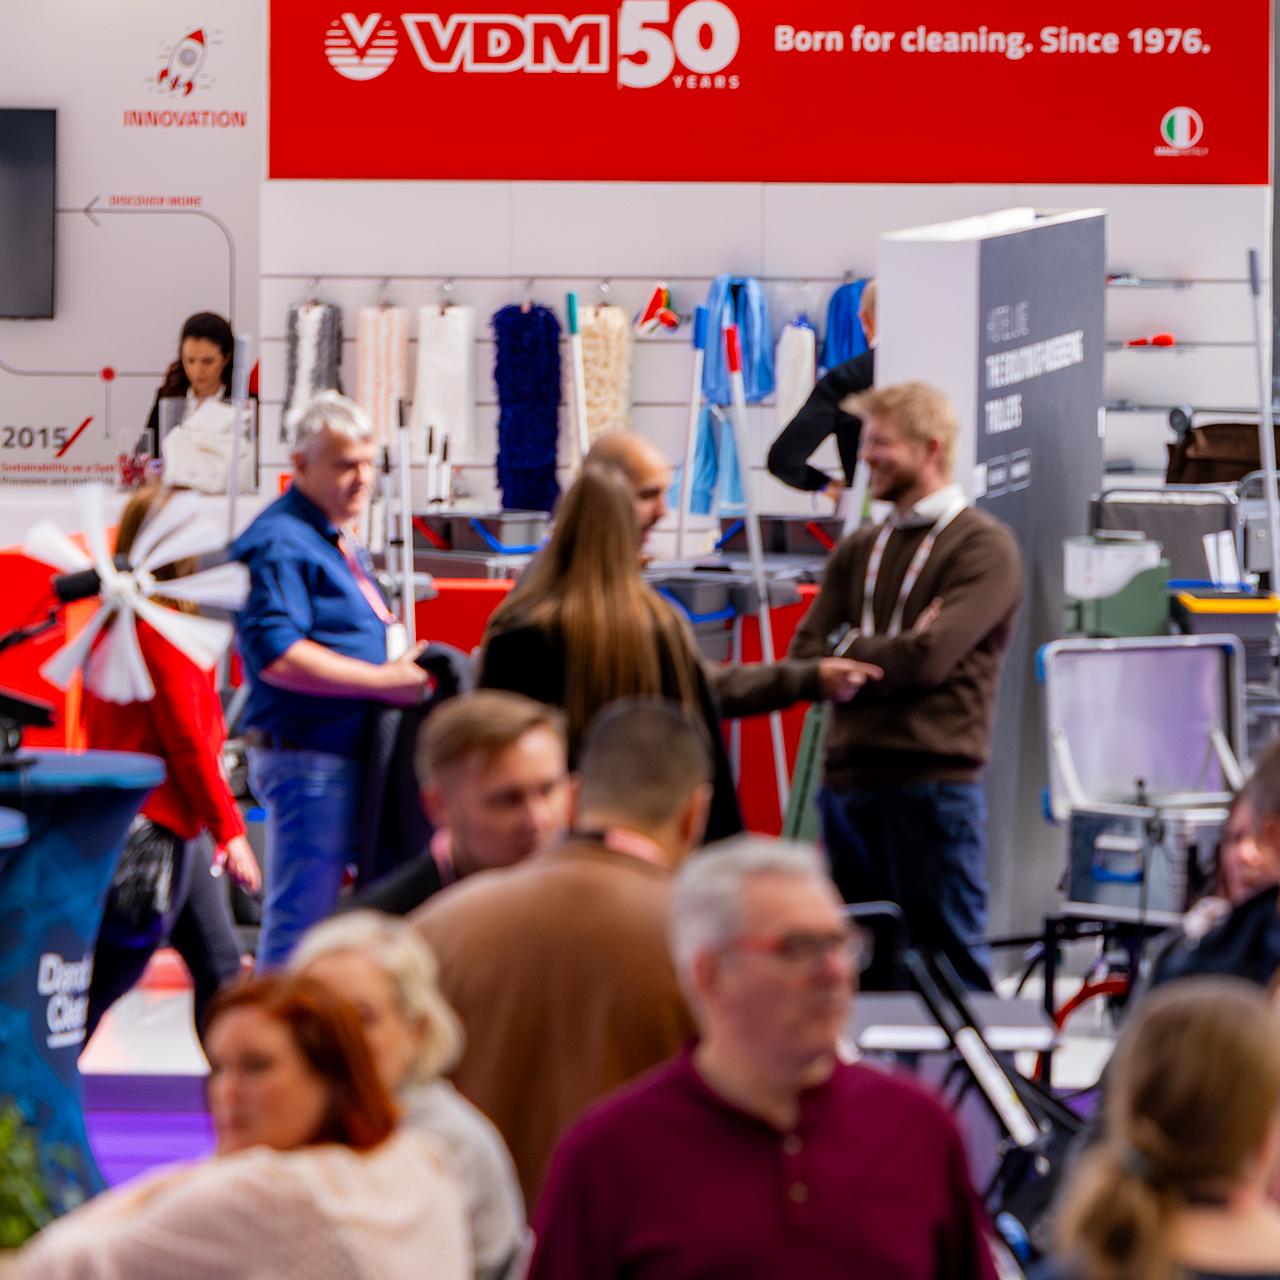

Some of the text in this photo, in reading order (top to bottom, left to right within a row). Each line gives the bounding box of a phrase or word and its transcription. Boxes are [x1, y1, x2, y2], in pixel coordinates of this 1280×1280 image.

[400, 13, 610, 74] VDM
[774, 24, 1212, 61] Born for cleaning. Since 1976.
[672, 75, 741, 90] YEARS
[123, 110, 248, 129] INNOVATION
